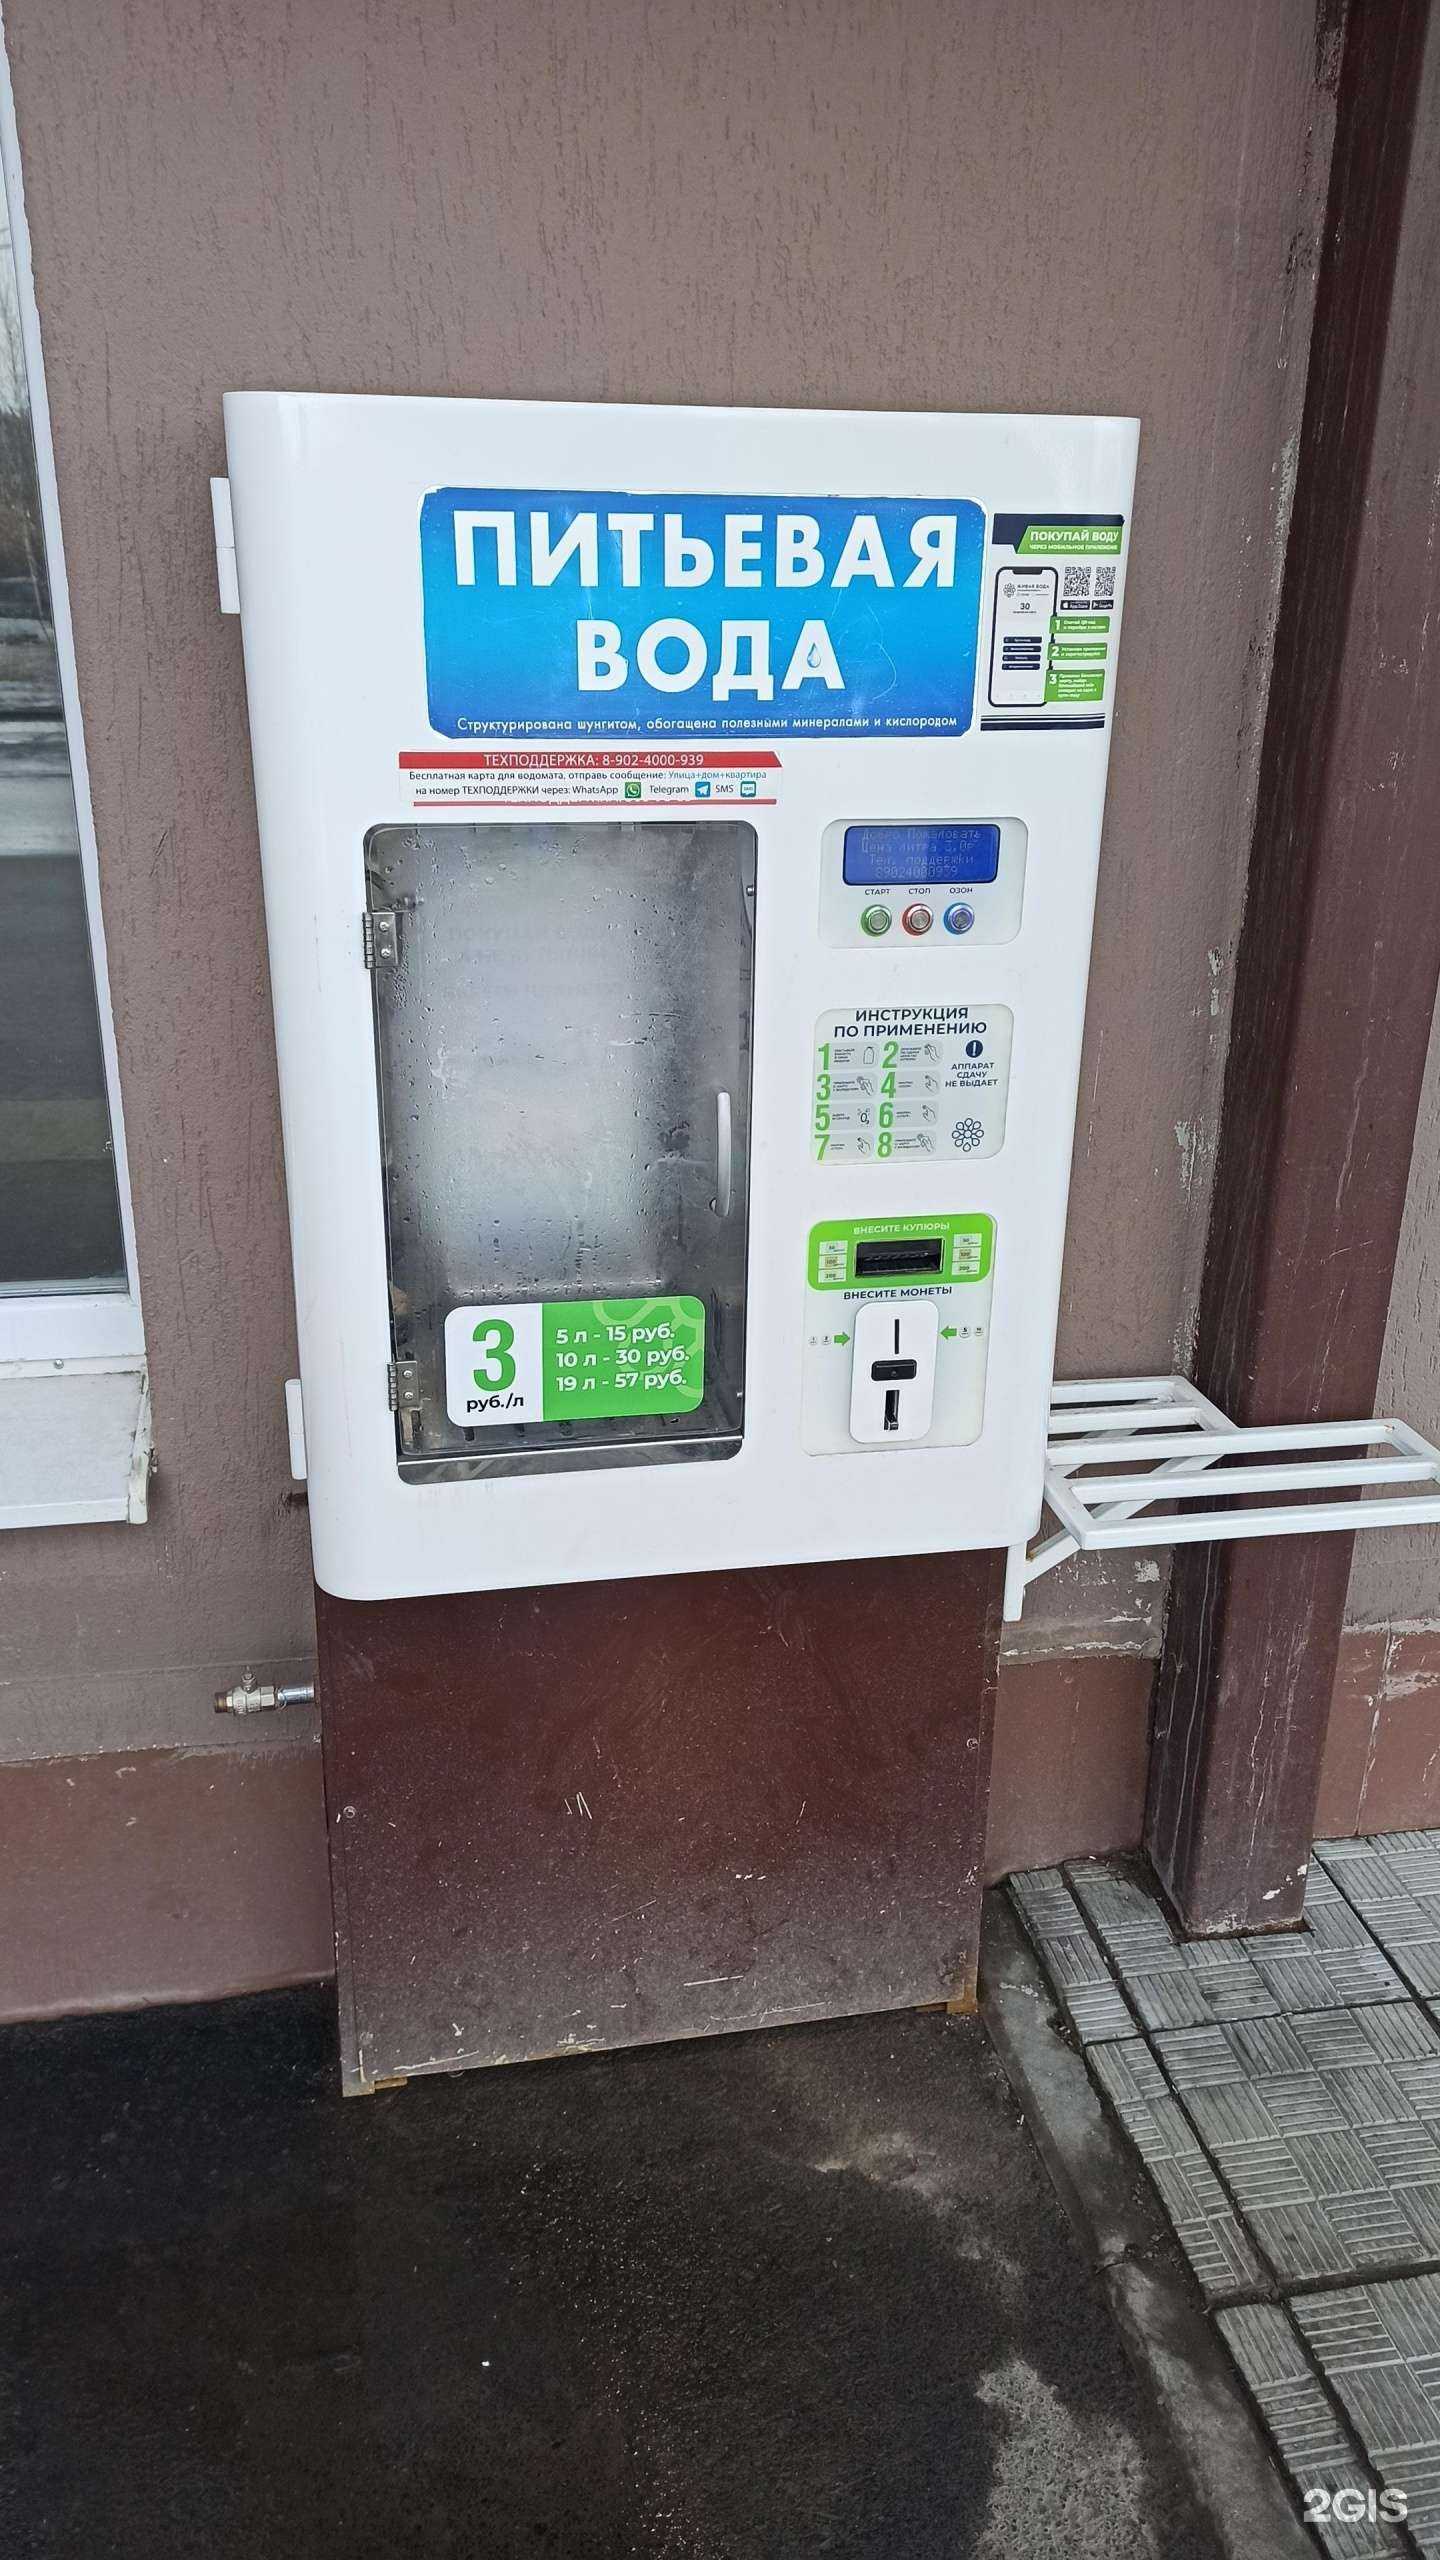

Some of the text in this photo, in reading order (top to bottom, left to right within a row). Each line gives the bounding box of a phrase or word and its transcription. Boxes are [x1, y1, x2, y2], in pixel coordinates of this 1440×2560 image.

[1030, 529, 1119, 543] ПОКУПАЙ ВОДУ
[453, 510, 958, 588] ПИТЬЕВАЯ
[1020, 602, 1031, 610] 30
[1055, 619, 1061, 631] 1
[1051, 645, 1060, 657] 2
[576, 618, 845, 701] ВОДА
[1049, 673, 1057, 685] 3
[457, 715, 957, 734] Структурирована шунгитом, обогащена полезными минералами и кислородом
[483, 754, 704, 768] ТЕХПОДДЕРЖКА: 8-902-4000-939
[409, 771, 466, 781] Бесплатная
[468, 772, 495, 783] карта
[497, 772, 515, 782] для
[568, 771, 607, 783] отправь
[610, 771, 667, 782] сообщение:
[415, 787, 428, 795] на
[429, 786, 460, 797] номер
[462, 785, 539, 796] ТЕХПОДДЕРЖКИ
[573, 784, 619, 797] WhatsApp
[650, 785, 690, 796] Telegram
[715, 784, 734, 793] SMS
[864, 888, 891, 896] СТАРТ
[908, 887, 931, 896] СТОП
[949, 887, 973, 895] ОЗОН
[855, 1007, 969, 1023] ИНСТРУКЦИЯ
[834, 1022, 987, 1038] ПО ПРИМЕНЕНИЮ
[818, 1043, 830, 1070] 1
[882, 1041, 899, 1069] 2
[951, 1062, 995, 1071] АППАРАТ
[956, 1071, 988, 1079] СДАЧУ
[816, 1074, 831, 1101] 3
[880, 1071, 897, 1099] 4
[945, 1079, 999, 1088] НЕ ВЫДАЕТ
[815, 1104, 831, 1131] 5
[879, 1102, 894, 1129] 6
[814, 1134, 830, 1161] 7
[877, 1132, 892, 1158] 8
[853, 1222, 950, 1235] ВНЕСИТЕ КУПЮРЫ
[843, 1286, 953, 1300] ВНЕСИТЕ МОНЕТЫ
[556, 1329, 569, 1344] 5
[573, 1330, 587, 1344] л
[606, 1326, 626, 1342] 15
[631, 1322, 675, 1344] руб.
[472, 1319, 516, 1392] 3
[556, 1352, 578, 1368] 10
[583, 1353, 597, 1367] л
[615, 1349, 640, 1365] 30
[646, 1345, 690, 1367] руб.
[556, 1376, 577, 1392] 19
[581, 1377, 596, 1390] л
[614, 1372, 639, 1388] 57
[644, 1369, 687, 1391] руб.
[466, 1393, 525, 1413] руб./л
